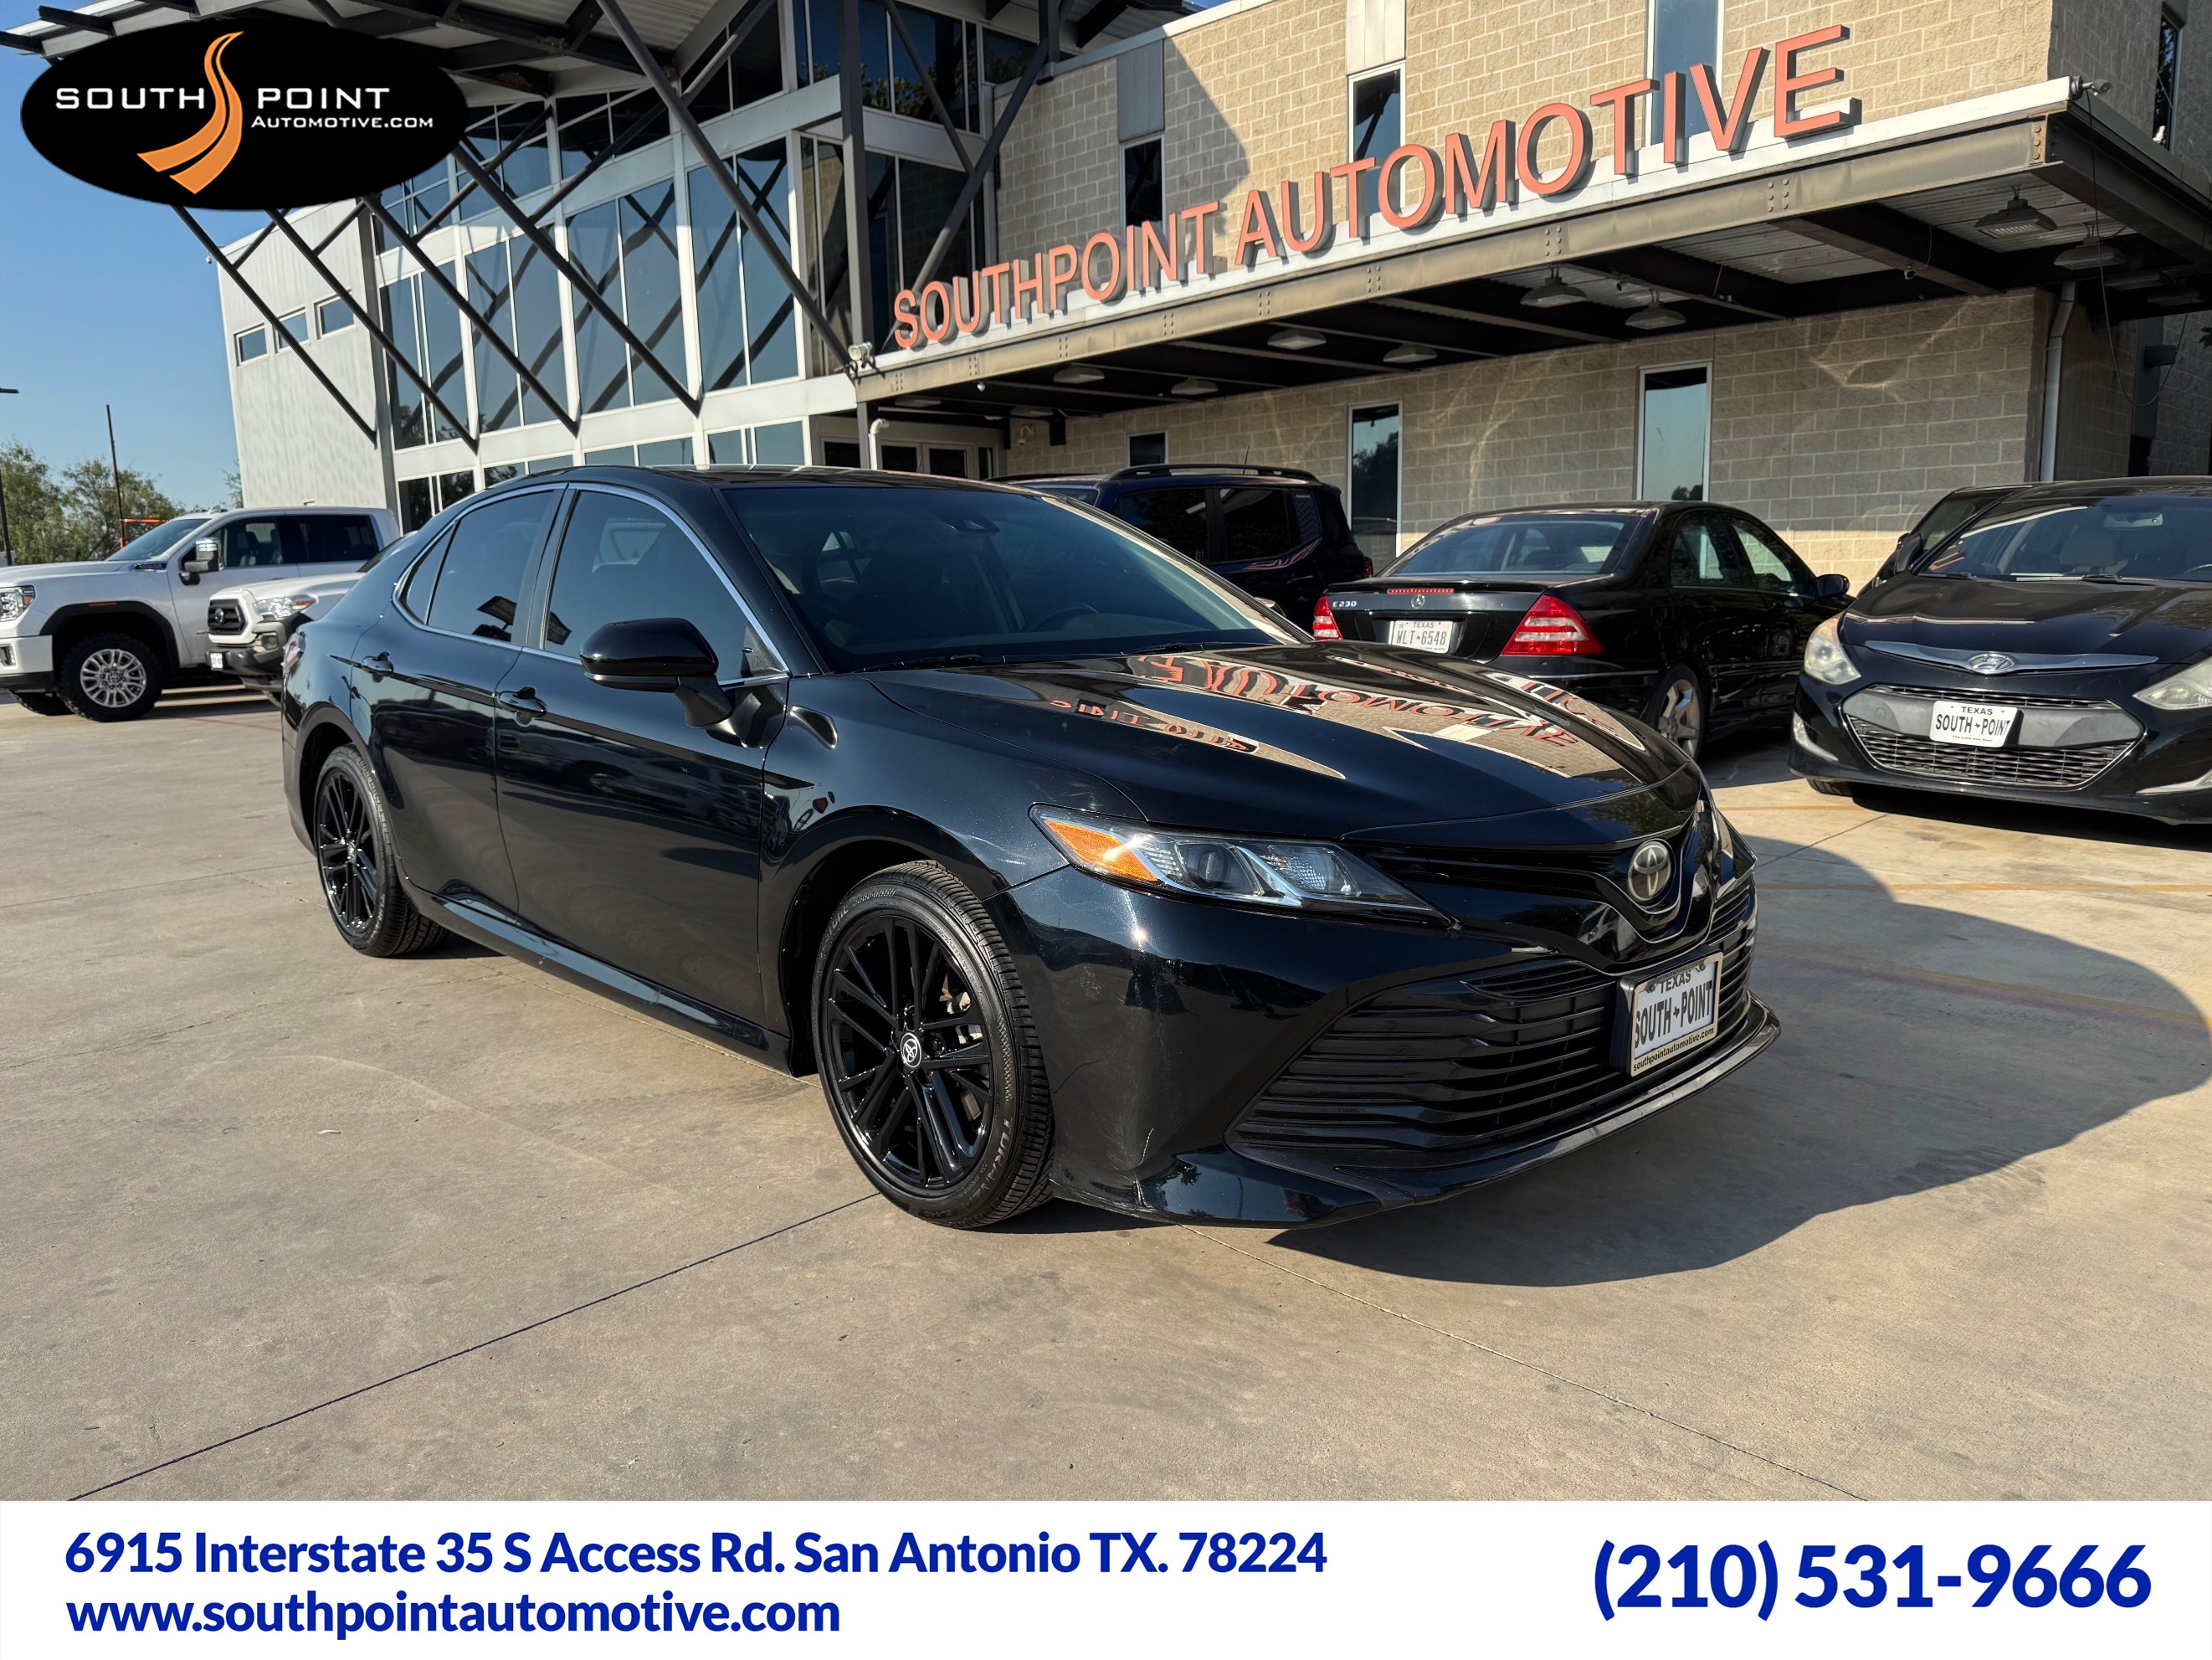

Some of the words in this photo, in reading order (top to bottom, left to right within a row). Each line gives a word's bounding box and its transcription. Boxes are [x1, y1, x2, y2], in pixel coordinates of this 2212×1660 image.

[893, 200, 1222, 349] SOUTHPOINT
[1234, 23, 1850, 266] AUTOMOTIVE
[1935, 713, 1973, 733] SOUTH
[1981, 717, 2011, 737] POINT
[1961, 706, 1994, 716] TEXAS
[1660, 969, 1692, 994] TEXAS
[1635, 997, 1672, 1049] SOUTH
[1680, 979, 1713, 1028] POINT
[1633, 1026, 1714, 1072] southpointautomotive.com
